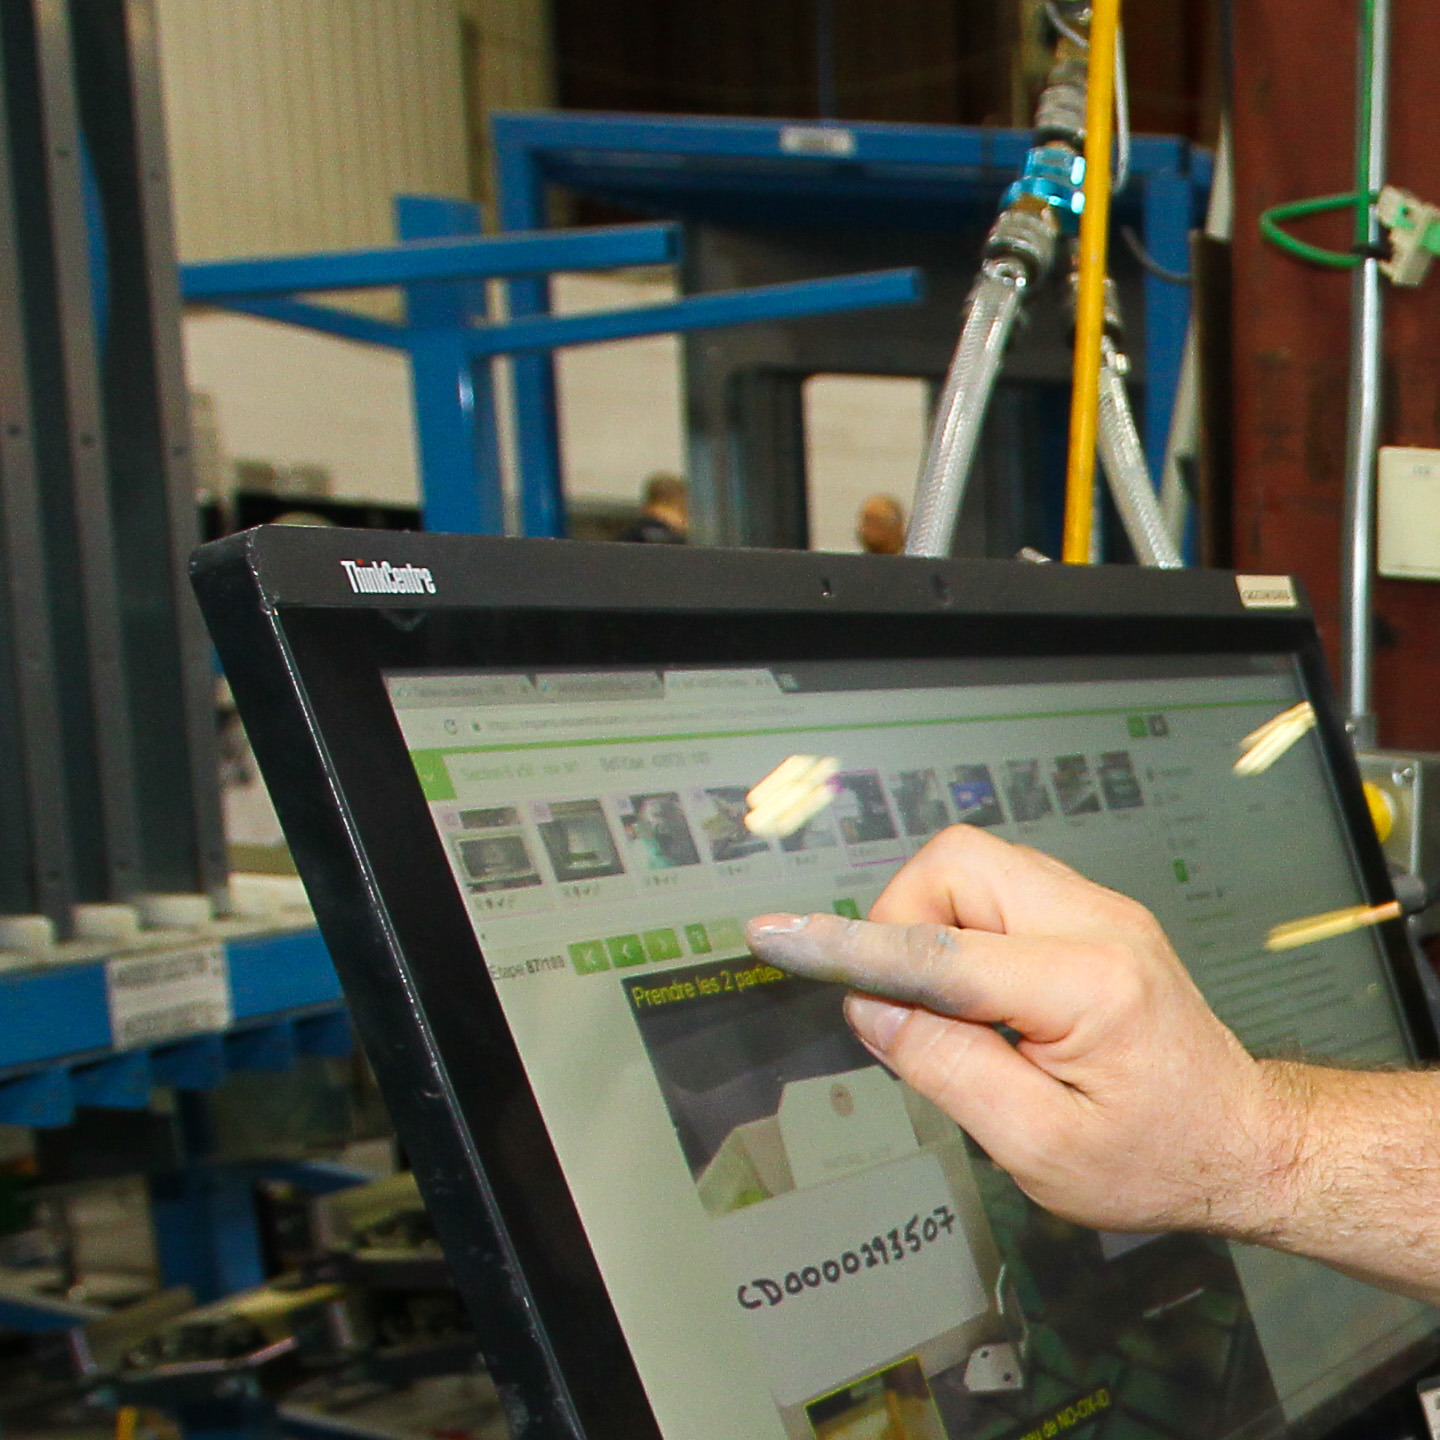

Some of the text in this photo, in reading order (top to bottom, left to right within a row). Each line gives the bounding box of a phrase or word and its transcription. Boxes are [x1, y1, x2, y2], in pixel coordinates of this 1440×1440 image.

[340, 559, 437, 594] ThinkCentre
[631, 980, 695, 1007] Prendre
[699, 975, 721, 995] les
[721, 971, 735, 992] 2
[736, 1205, 956, 1310] CD0000293507
